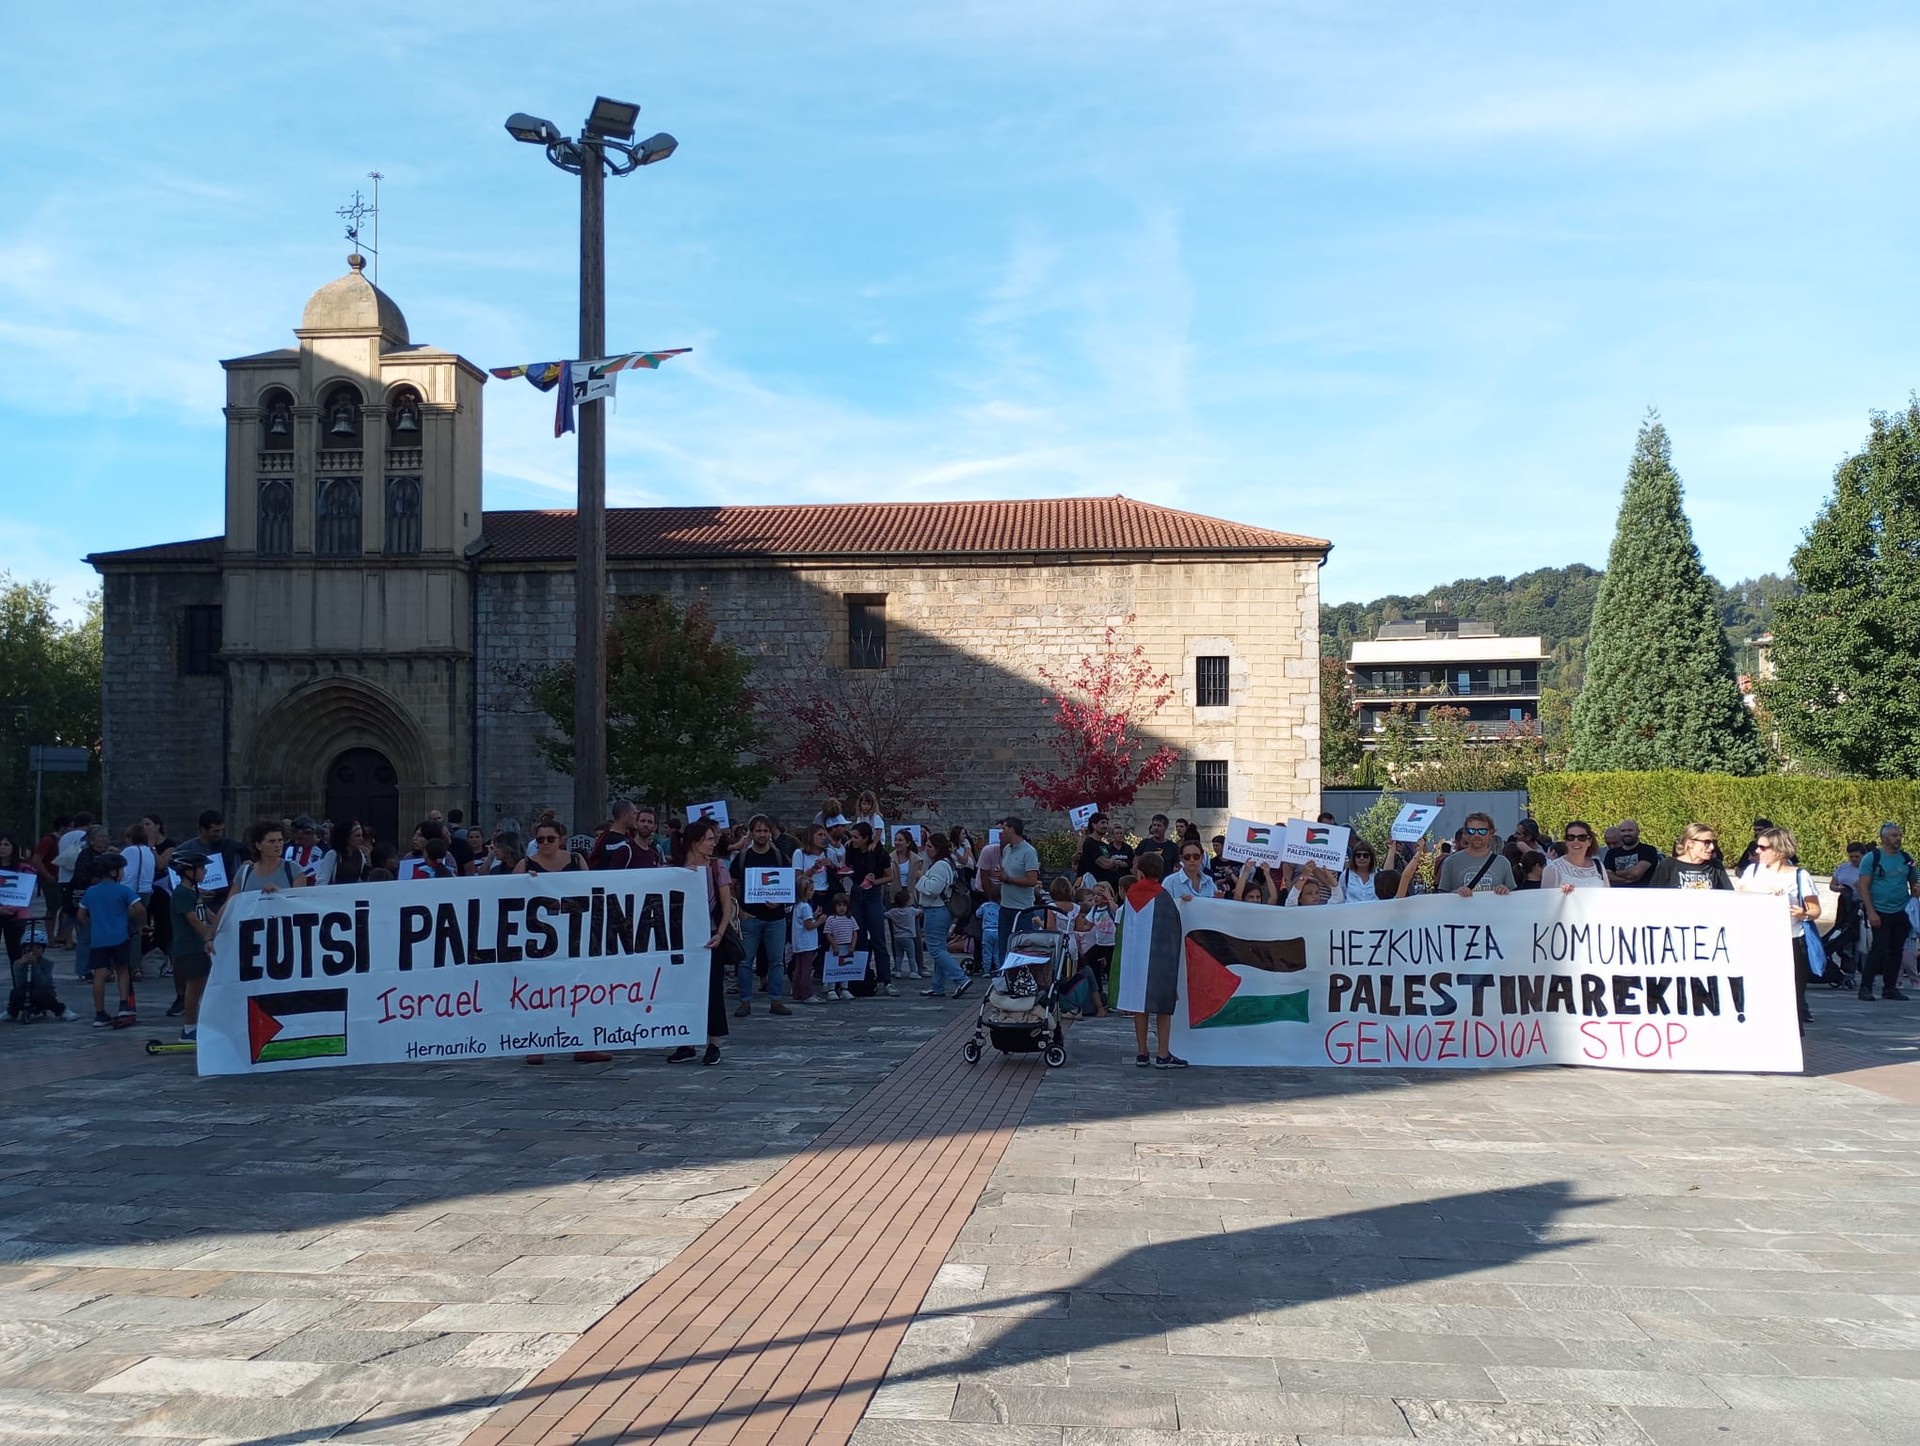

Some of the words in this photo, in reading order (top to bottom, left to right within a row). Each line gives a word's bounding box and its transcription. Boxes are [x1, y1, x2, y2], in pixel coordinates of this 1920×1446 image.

[1227, 845, 1278, 860] PALESTINAREKIN!
[1287, 848, 1341, 862] PALESTINAREKIN!
[1330, 924, 1504, 966] HEZKUNTZA
[1532, 922, 1730, 966] KOMUNITATEA
[377, 980, 483, 1024] Israel
[1328, 973, 1746, 1023] PALESTINAREKIN!
[405, 1035, 487, 1059] Hernaniko
[593, 1020, 690, 1047] Plataforma
[1325, 1019, 1548, 1065] GENOZIDIOA
[1580, 1021, 1688, 1060] STOP
